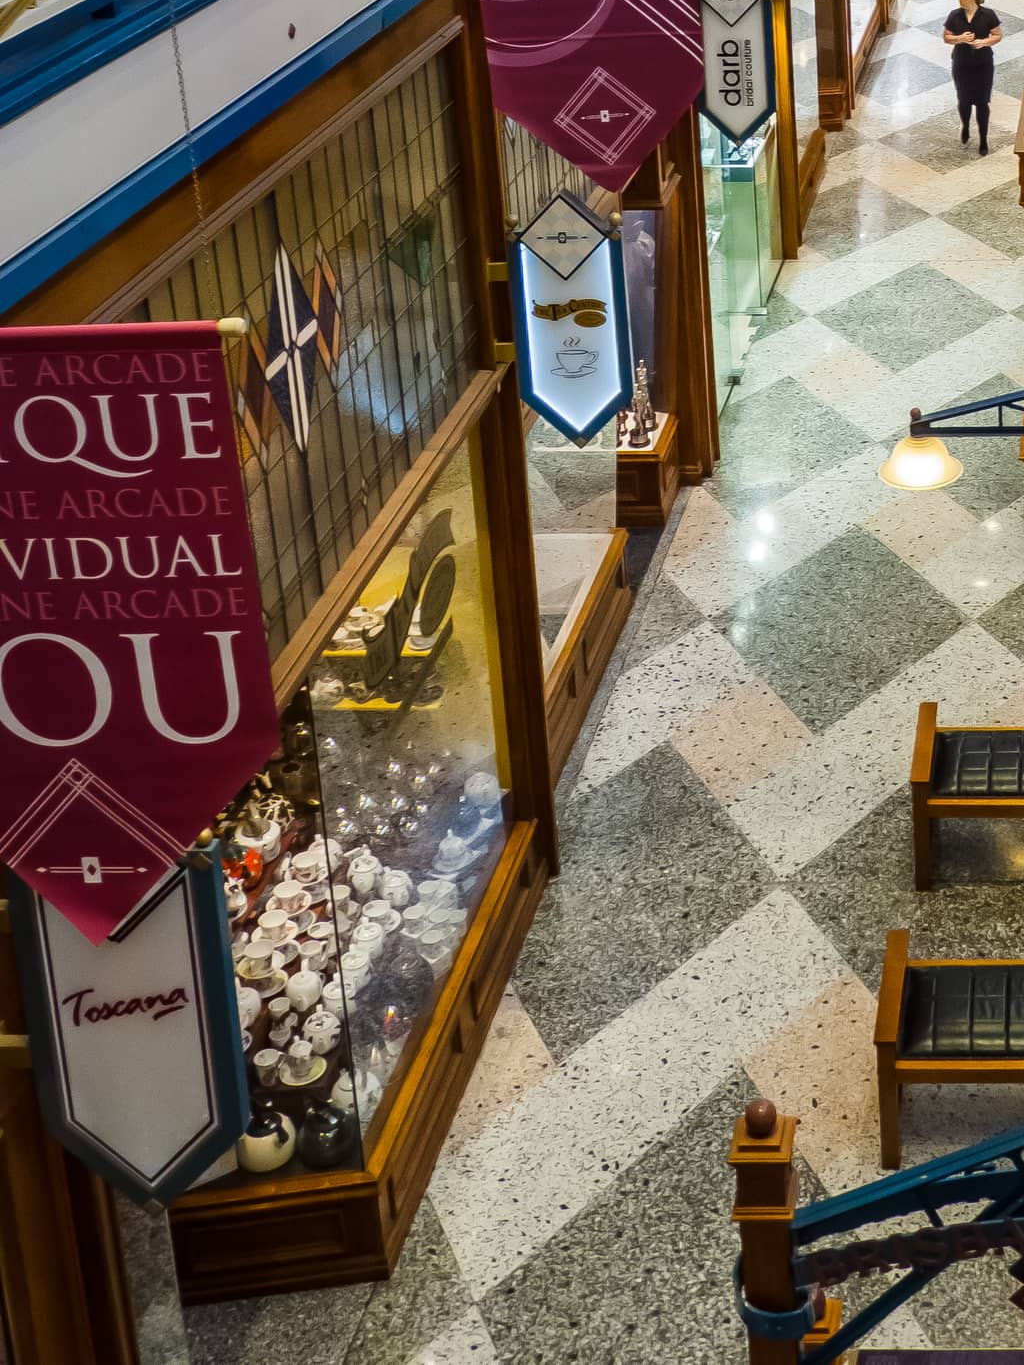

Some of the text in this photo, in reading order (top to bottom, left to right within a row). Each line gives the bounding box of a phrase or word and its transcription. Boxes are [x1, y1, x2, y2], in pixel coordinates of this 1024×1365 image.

[717, 40, 742, 107] darb
[35, 351, 213, 386] ARCADE
[0, 392, 221, 478] QUE
[56, 485, 233, 520] ARCADE
[0, 534, 243, 580] VIDUAL
[73, 587, 249, 621] ARCADE
[62, 986, 190, 1027] Toscana
